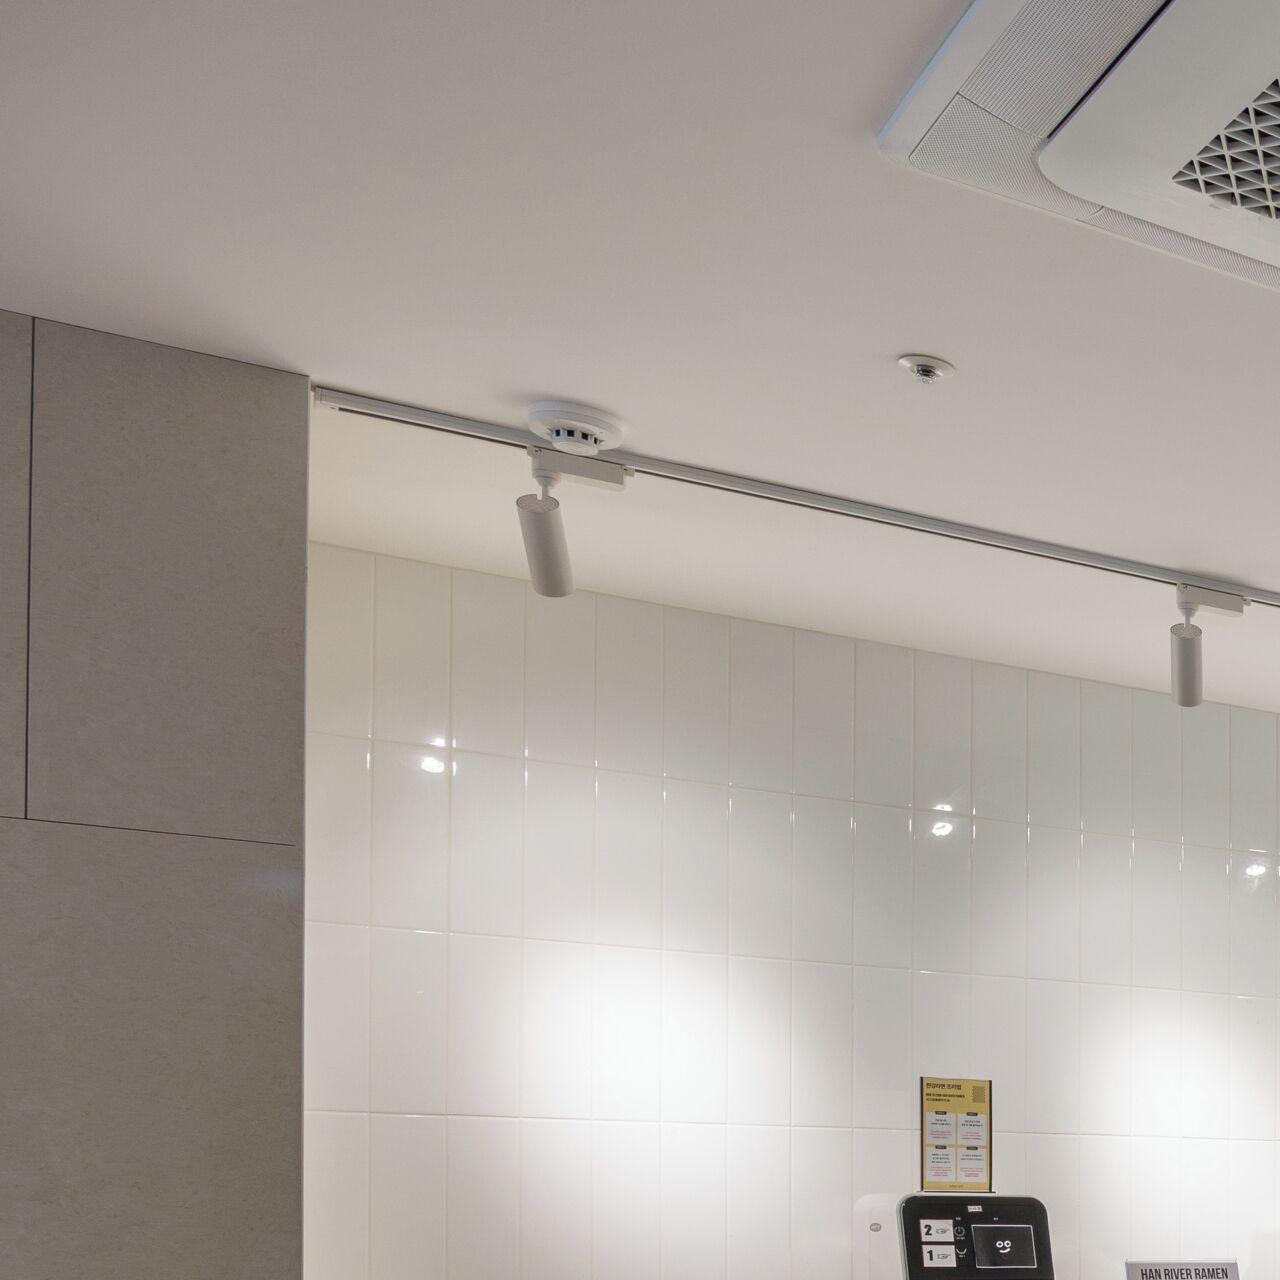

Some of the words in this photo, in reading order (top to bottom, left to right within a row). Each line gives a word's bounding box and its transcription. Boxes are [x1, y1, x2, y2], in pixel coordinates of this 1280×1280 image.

[924, 1224, 932, 1236] 2
[927, 1249, 934, 1261] 1
[1140, 1268, 1162, 1280] HAN
[1164, 1267, 1193, 1280] RIVER
[1194, 1267, 1229, 1280] RAMEN
